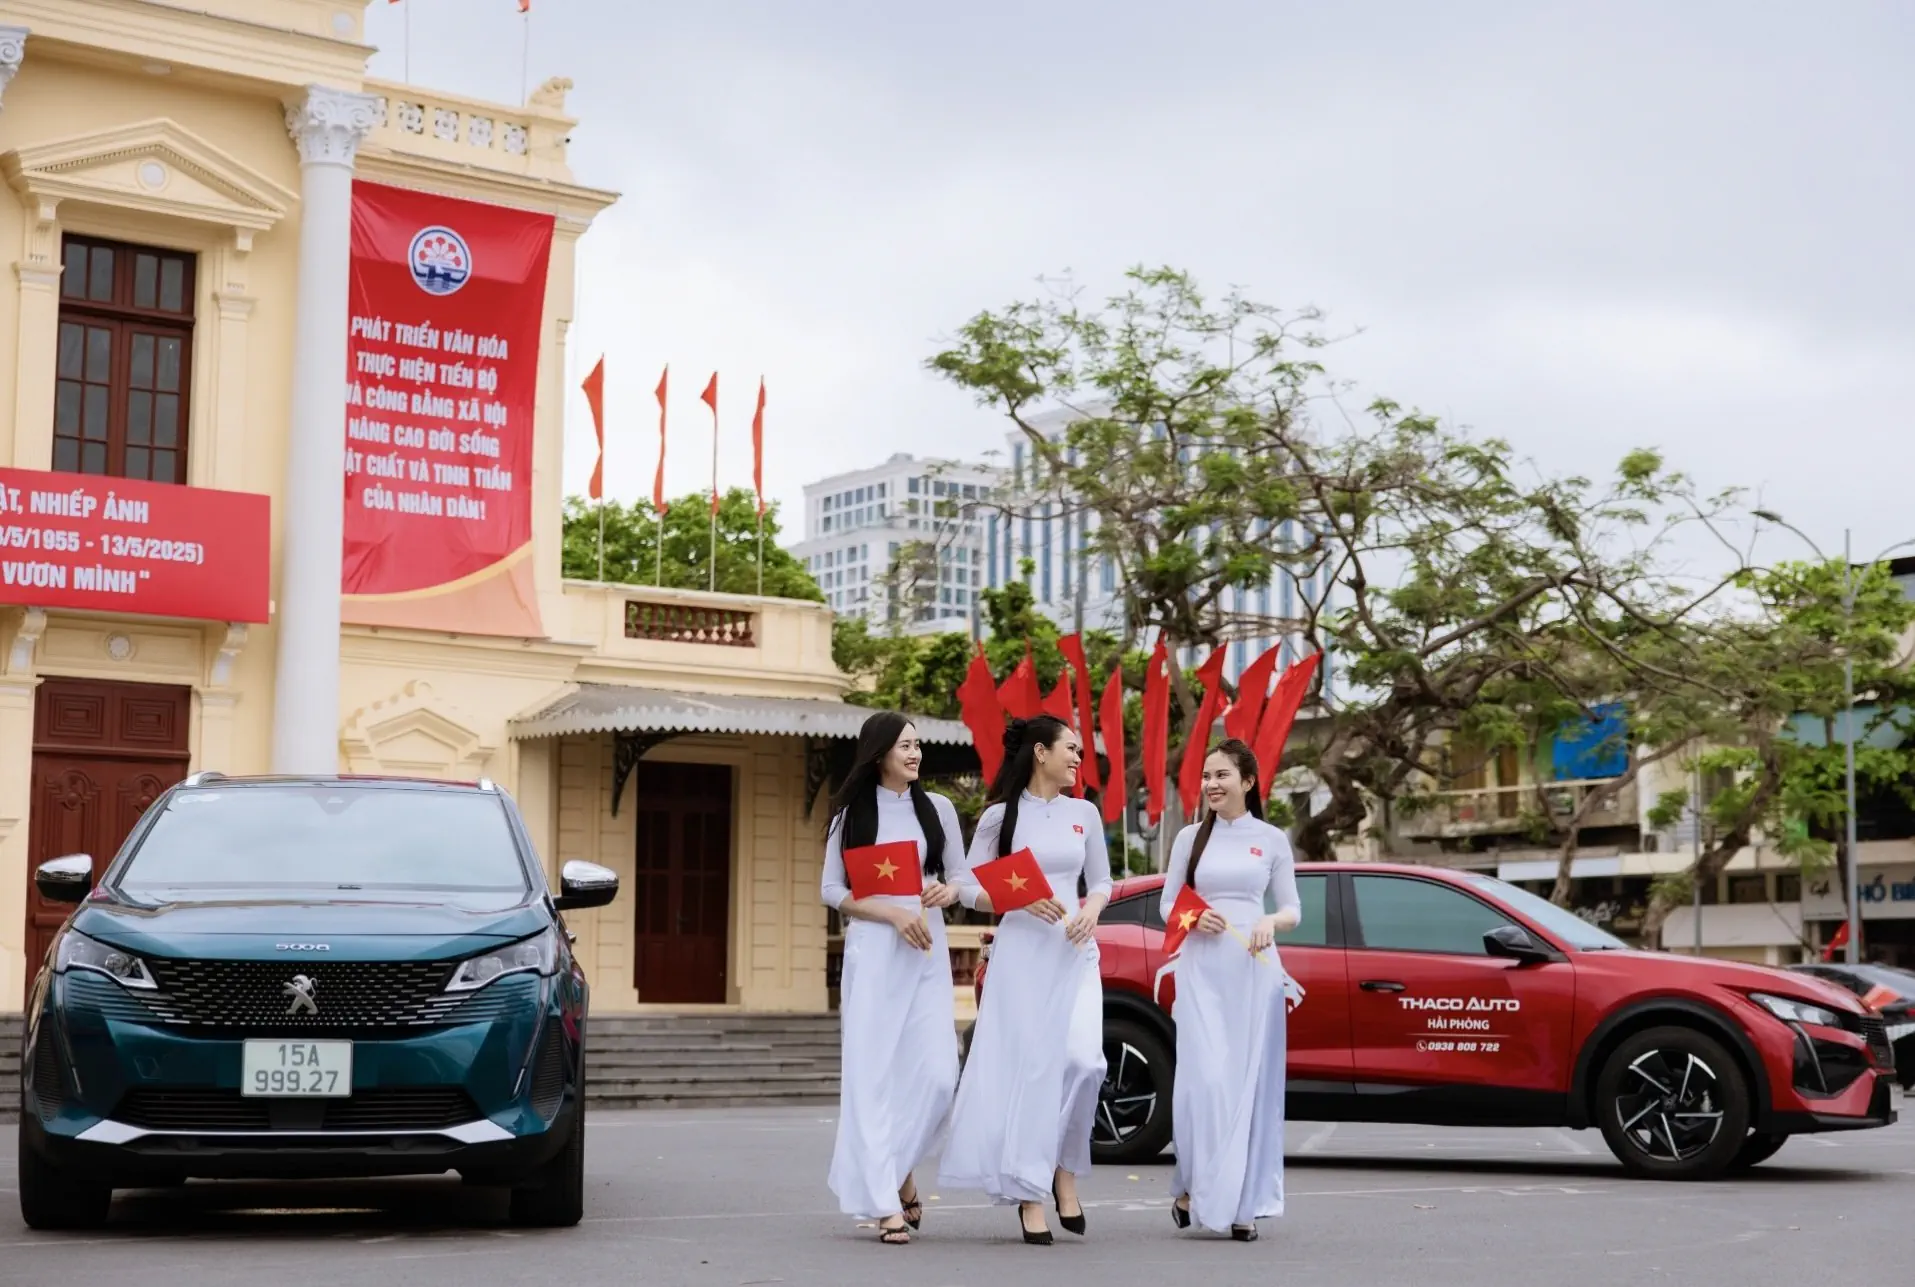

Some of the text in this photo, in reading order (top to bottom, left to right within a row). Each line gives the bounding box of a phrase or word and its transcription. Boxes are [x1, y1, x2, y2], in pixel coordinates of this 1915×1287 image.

[351, 316, 508, 360] PHÁT TRIỂN VĂN HÓA
[357, 351, 497, 395] THỰC HIỆN TIẾN BỘ
[366, 385, 408, 413] CÔNG
[411, 388, 454, 419] BẰNG
[458, 398, 480, 421] XÃ
[483, 401, 508, 429] HỘI
[348, 416, 500, 458] NÂNG CAO ĐỜI SỐNG
[345, 447, 363, 476] ẬT
[366, 451, 405, 479] CHẤT
[408, 457, 430, 482] VÀ
[433, 463, 470, 487] TINH
[30, 488, 97, 518] NHIẾP
[102, 491, 149, 523] ẢNH
[363, 482, 486, 520] CỦA NHÂN DÂN!
[85, 540, 95, 548] -
[100, 533, 204, 565] 13/5/2025)
[2, 560, 67, 589] VƯƠN
[1398, 997, 1520, 1011] THACO AUTO
[1427, 1015, 1490, 1030] HẢI PHÒNG
[278, 1044, 320, 1067] 15A
[1480, 1042, 1500, 1052] 722
[255, 1070, 339, 1093] 999.27
